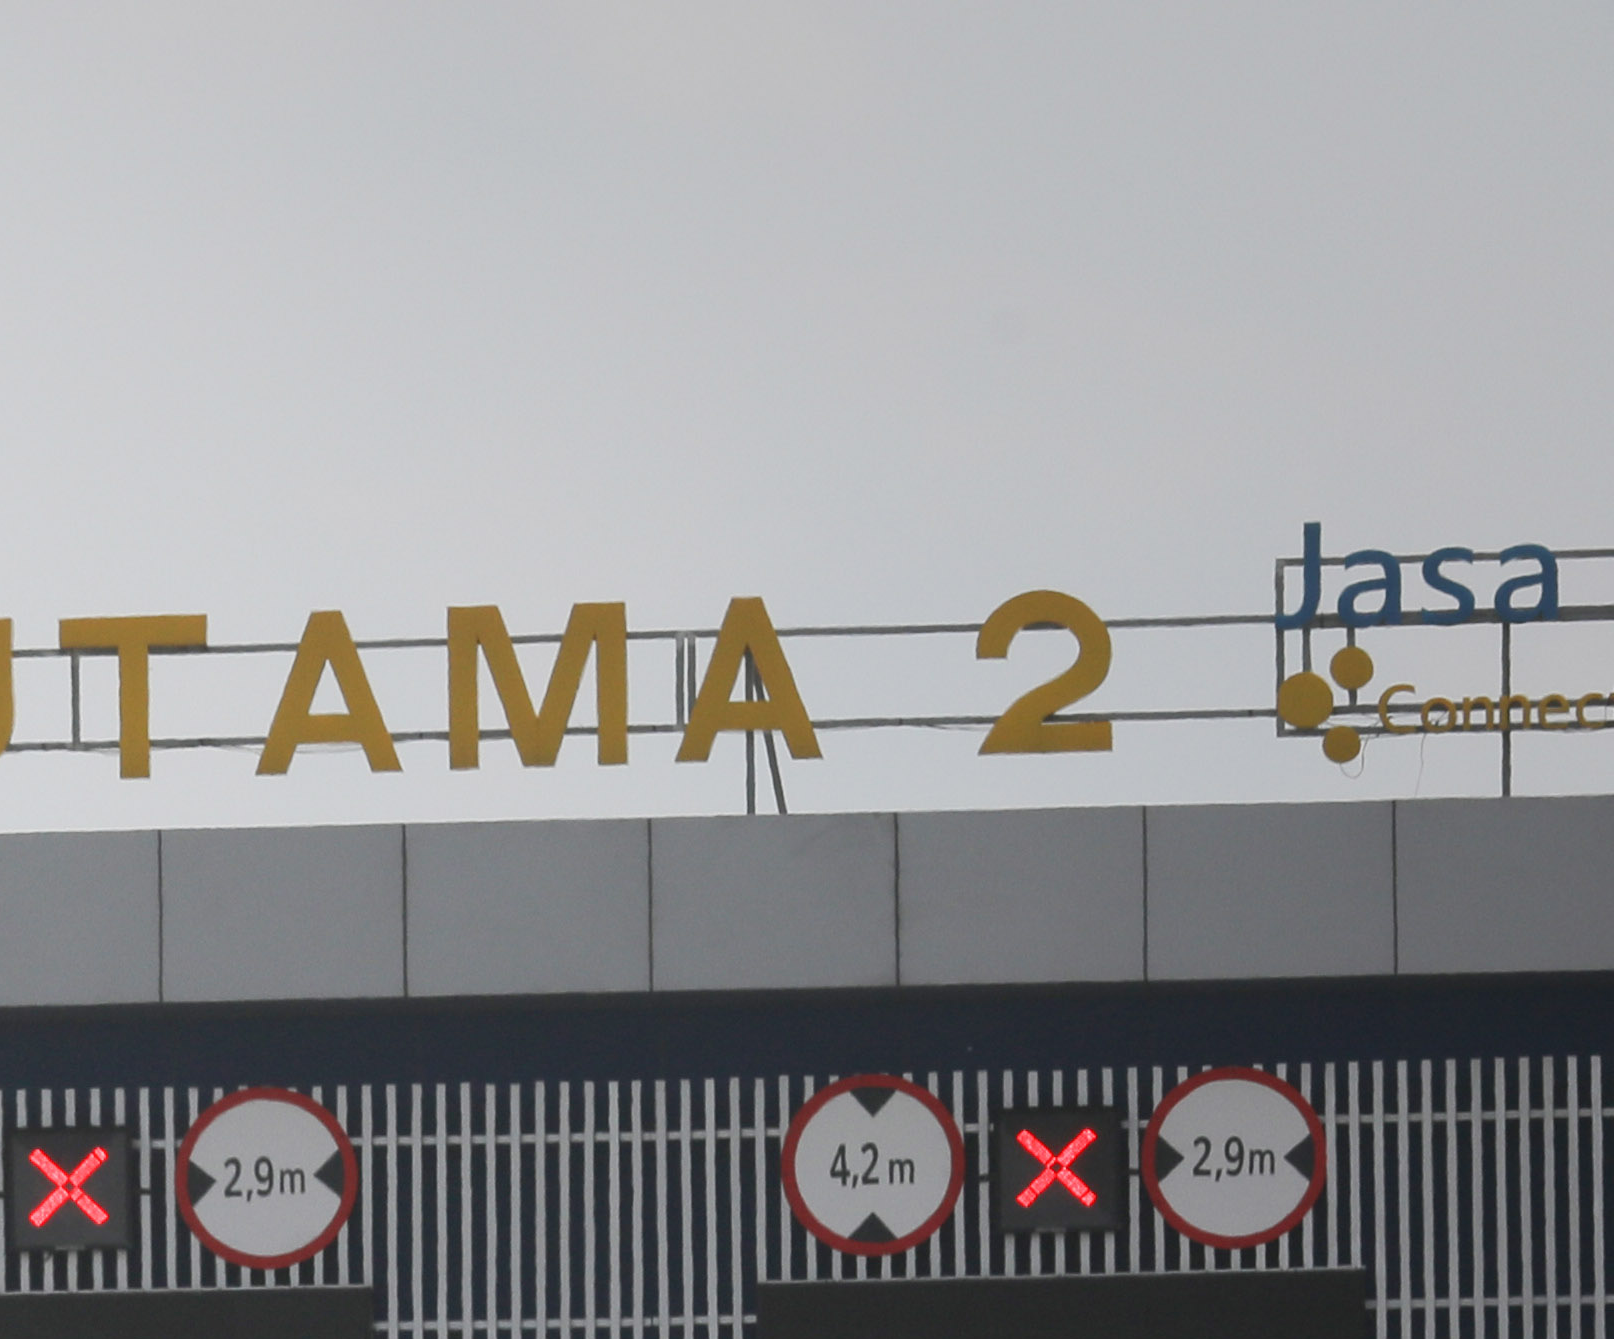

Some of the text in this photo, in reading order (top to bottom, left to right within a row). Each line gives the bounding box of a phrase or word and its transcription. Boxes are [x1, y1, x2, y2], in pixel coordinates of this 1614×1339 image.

[1275, 522, 1558, 630] Jasa
[973, 588, 1115, 756] 2
[1377, 683, 1614, 734] Connec
